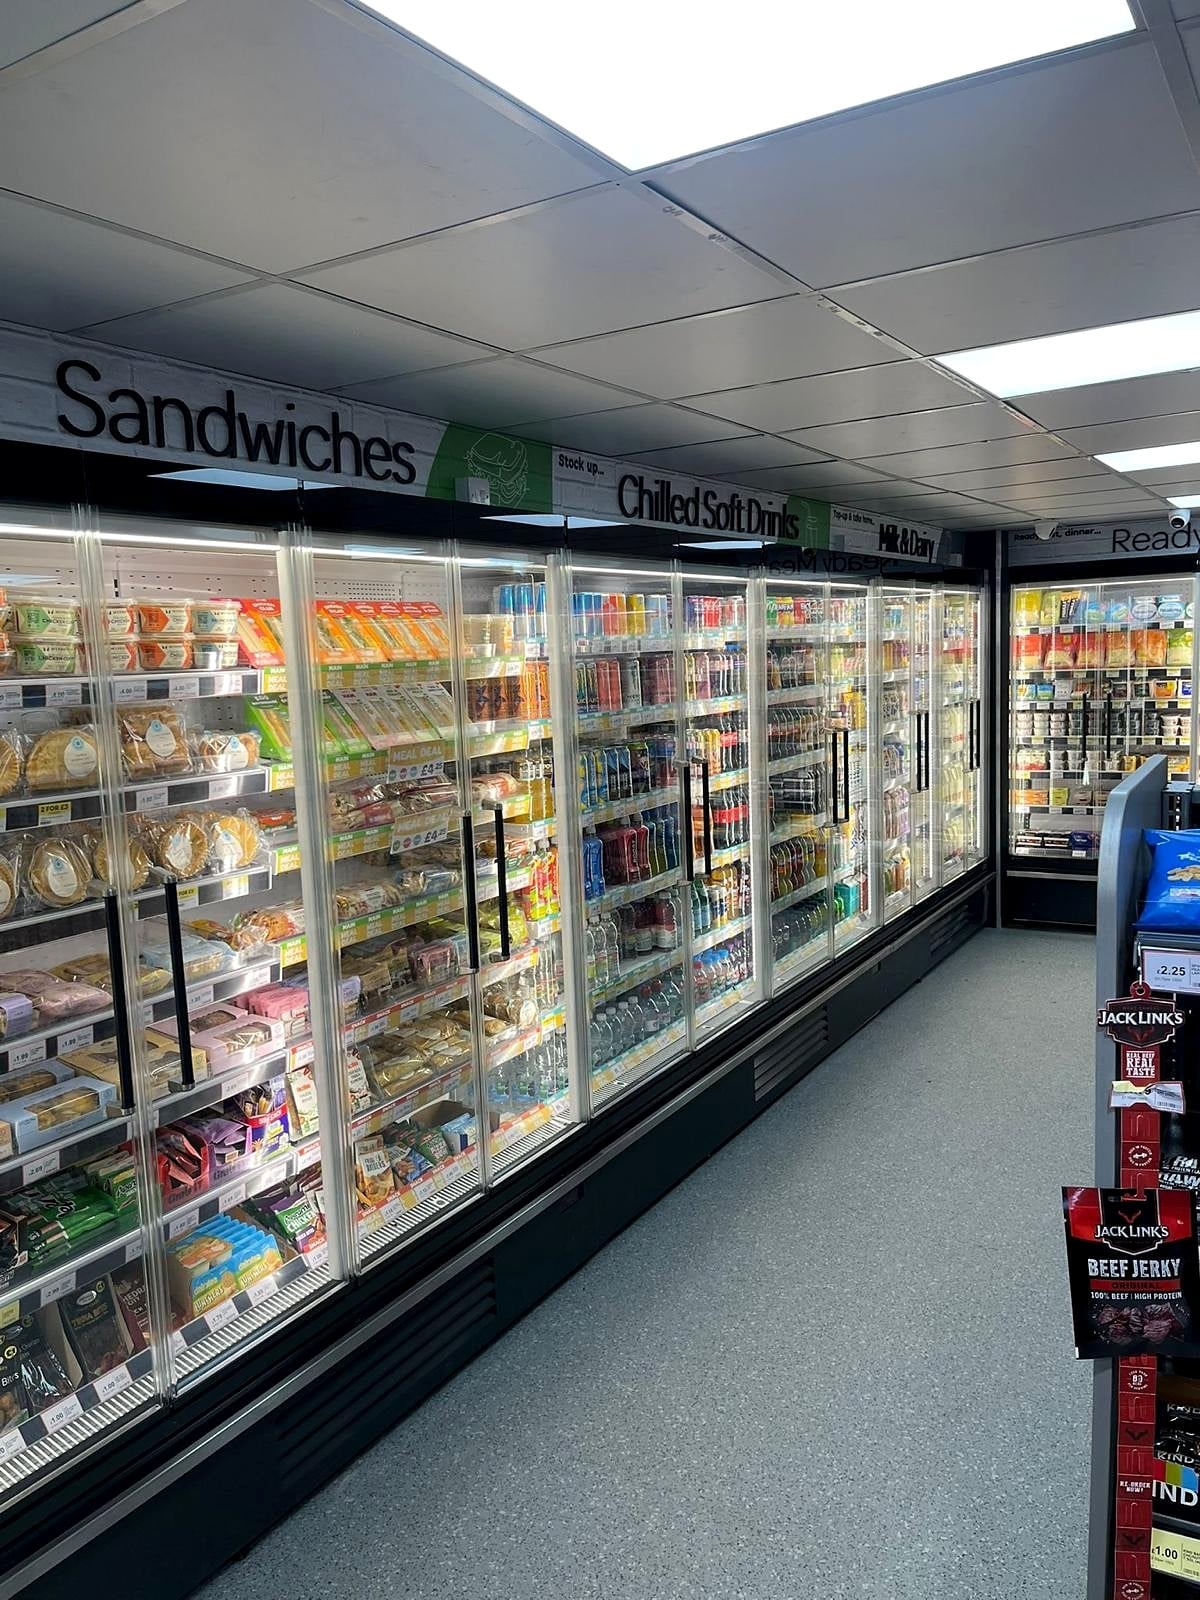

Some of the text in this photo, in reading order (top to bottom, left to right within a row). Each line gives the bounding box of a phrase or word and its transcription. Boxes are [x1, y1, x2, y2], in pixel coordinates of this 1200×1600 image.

[56, 359, 416, 485] Sandwiches
[558, 453, 604, 476] Stock up...
[618, 474, 799, 540] Chilled Soft Drinks
[1065, 527, 1102, 538] dinner...
[879, 523, 935, 563] Milk & Dairy
[393, 745, 442, 762] MEAL DEAL
[46, 804, 59, 812] FOR
[1099, 1010, 1183, 1026] JACK LINK'S
[1126, 1058, 1155, 1068] REAL
[1126, 1067, 1155, 1076] TASTE
[1095, 1224, 1169, 1238] JACK LINK'S
[1088, 1258, 1180, 1277] BEEF JERKY
[1112, 1281, 1162, 1289] ORIGINAL
[1090, 1291, 1110, 1300] 100%
[1154, 1292, 1182, 1300] PROTEIN
[1157, 1451, 1194, 1464] KIND
[1152, 1479, 1198, 1507] IND
